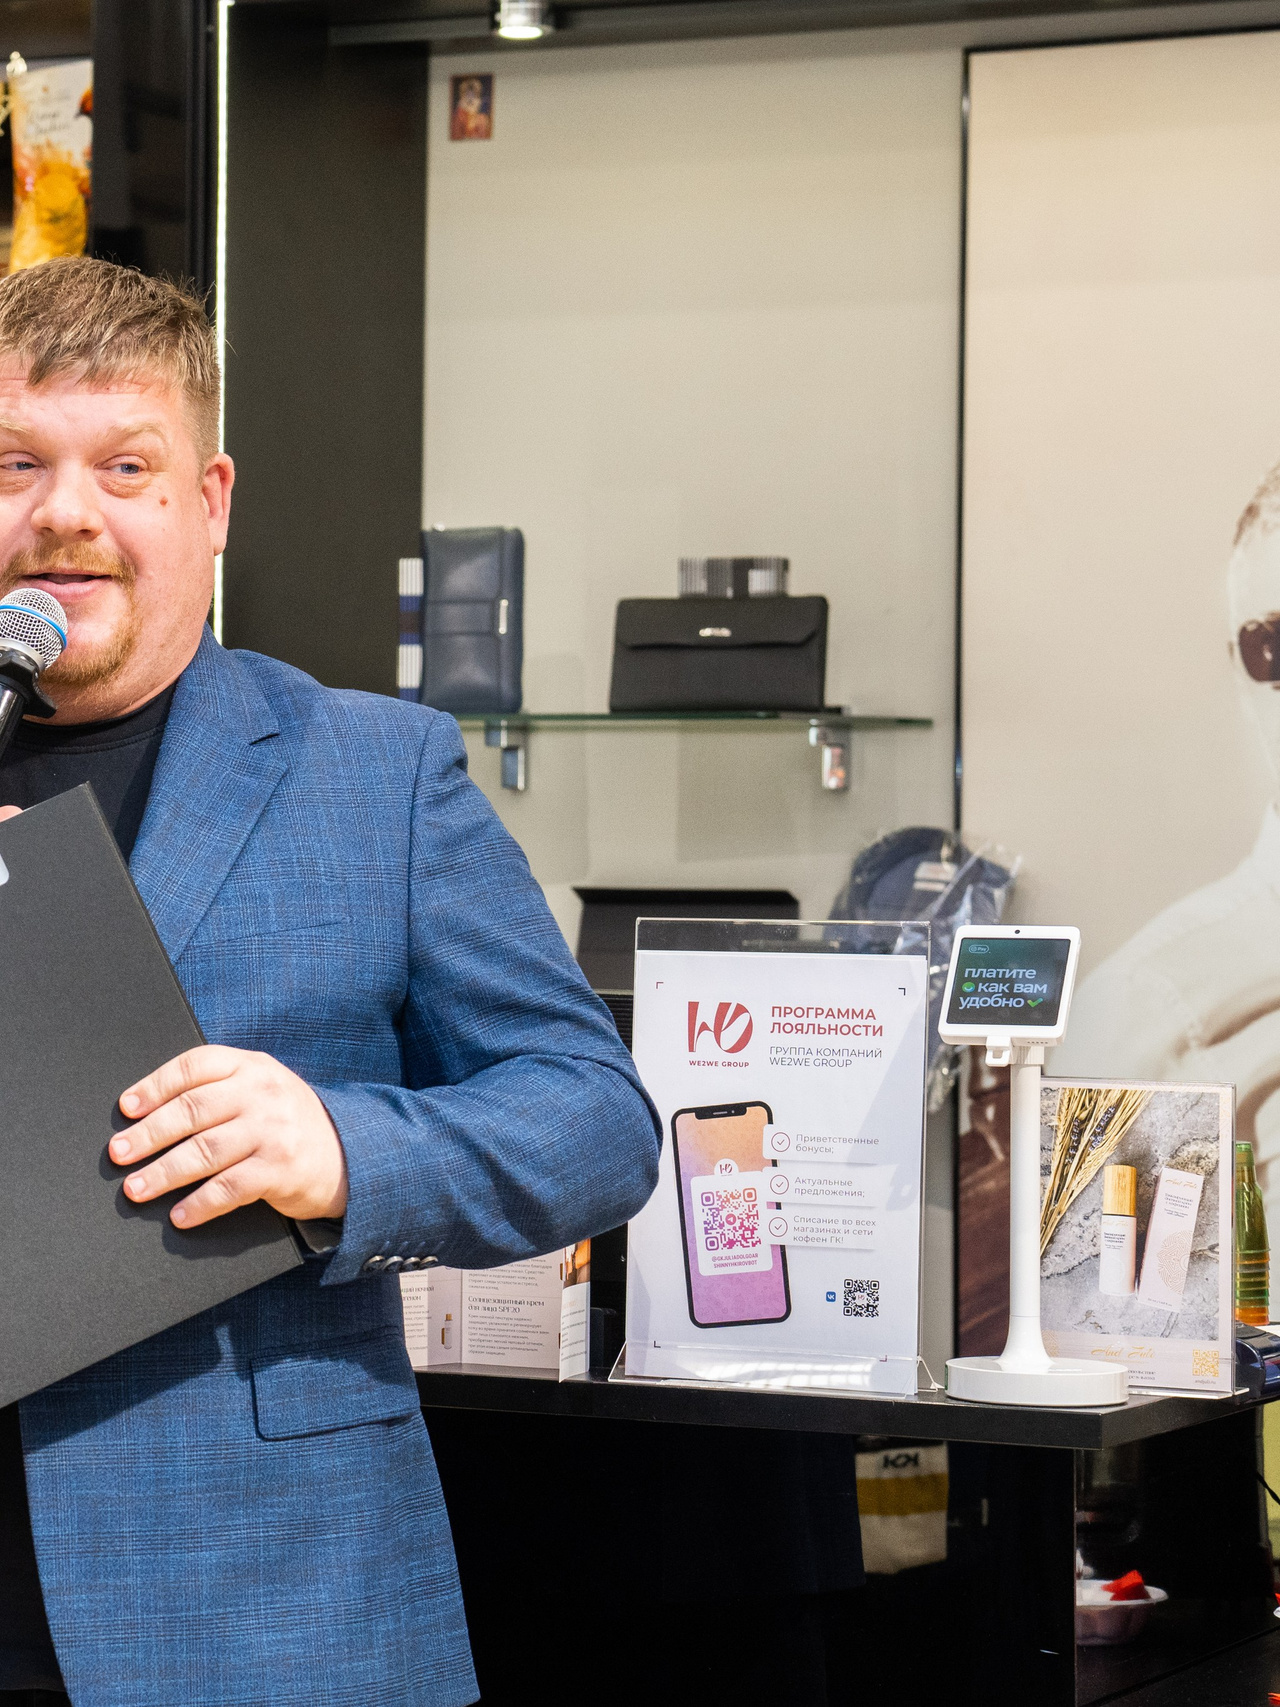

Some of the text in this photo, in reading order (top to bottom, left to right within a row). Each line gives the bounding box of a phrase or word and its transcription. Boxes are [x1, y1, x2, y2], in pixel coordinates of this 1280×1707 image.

[964, 967, 1037, 979] платите
[977, 982, 1048, 994] как вам
[958, 993, 1025, 1010] удобно
[771, 1005, 877, 1020] ПРОГРАММА
[770, 1022, 884, 1037] ЛОЯЛЬНОСТИ
[770, 1046, 883, 1058] ГРУППА КОМПАНИЙ
[769, 1057, 853, 1068] WE2WE GROUP
[795, 1133, 880, 1145] Приветственные
[795, 1144, 834, 1154] бонусы;
[794, 1176, 853, 1187] Актуальные
[794, 1187, 865, 1198] предложения;
[793, 1215, 840, 1225] Списание
[855, 1219, 877, 1227] всех
[793, 1226, 842, 1234] магазинах
[793, 1235, 844, 1244] кофеен ГК!
